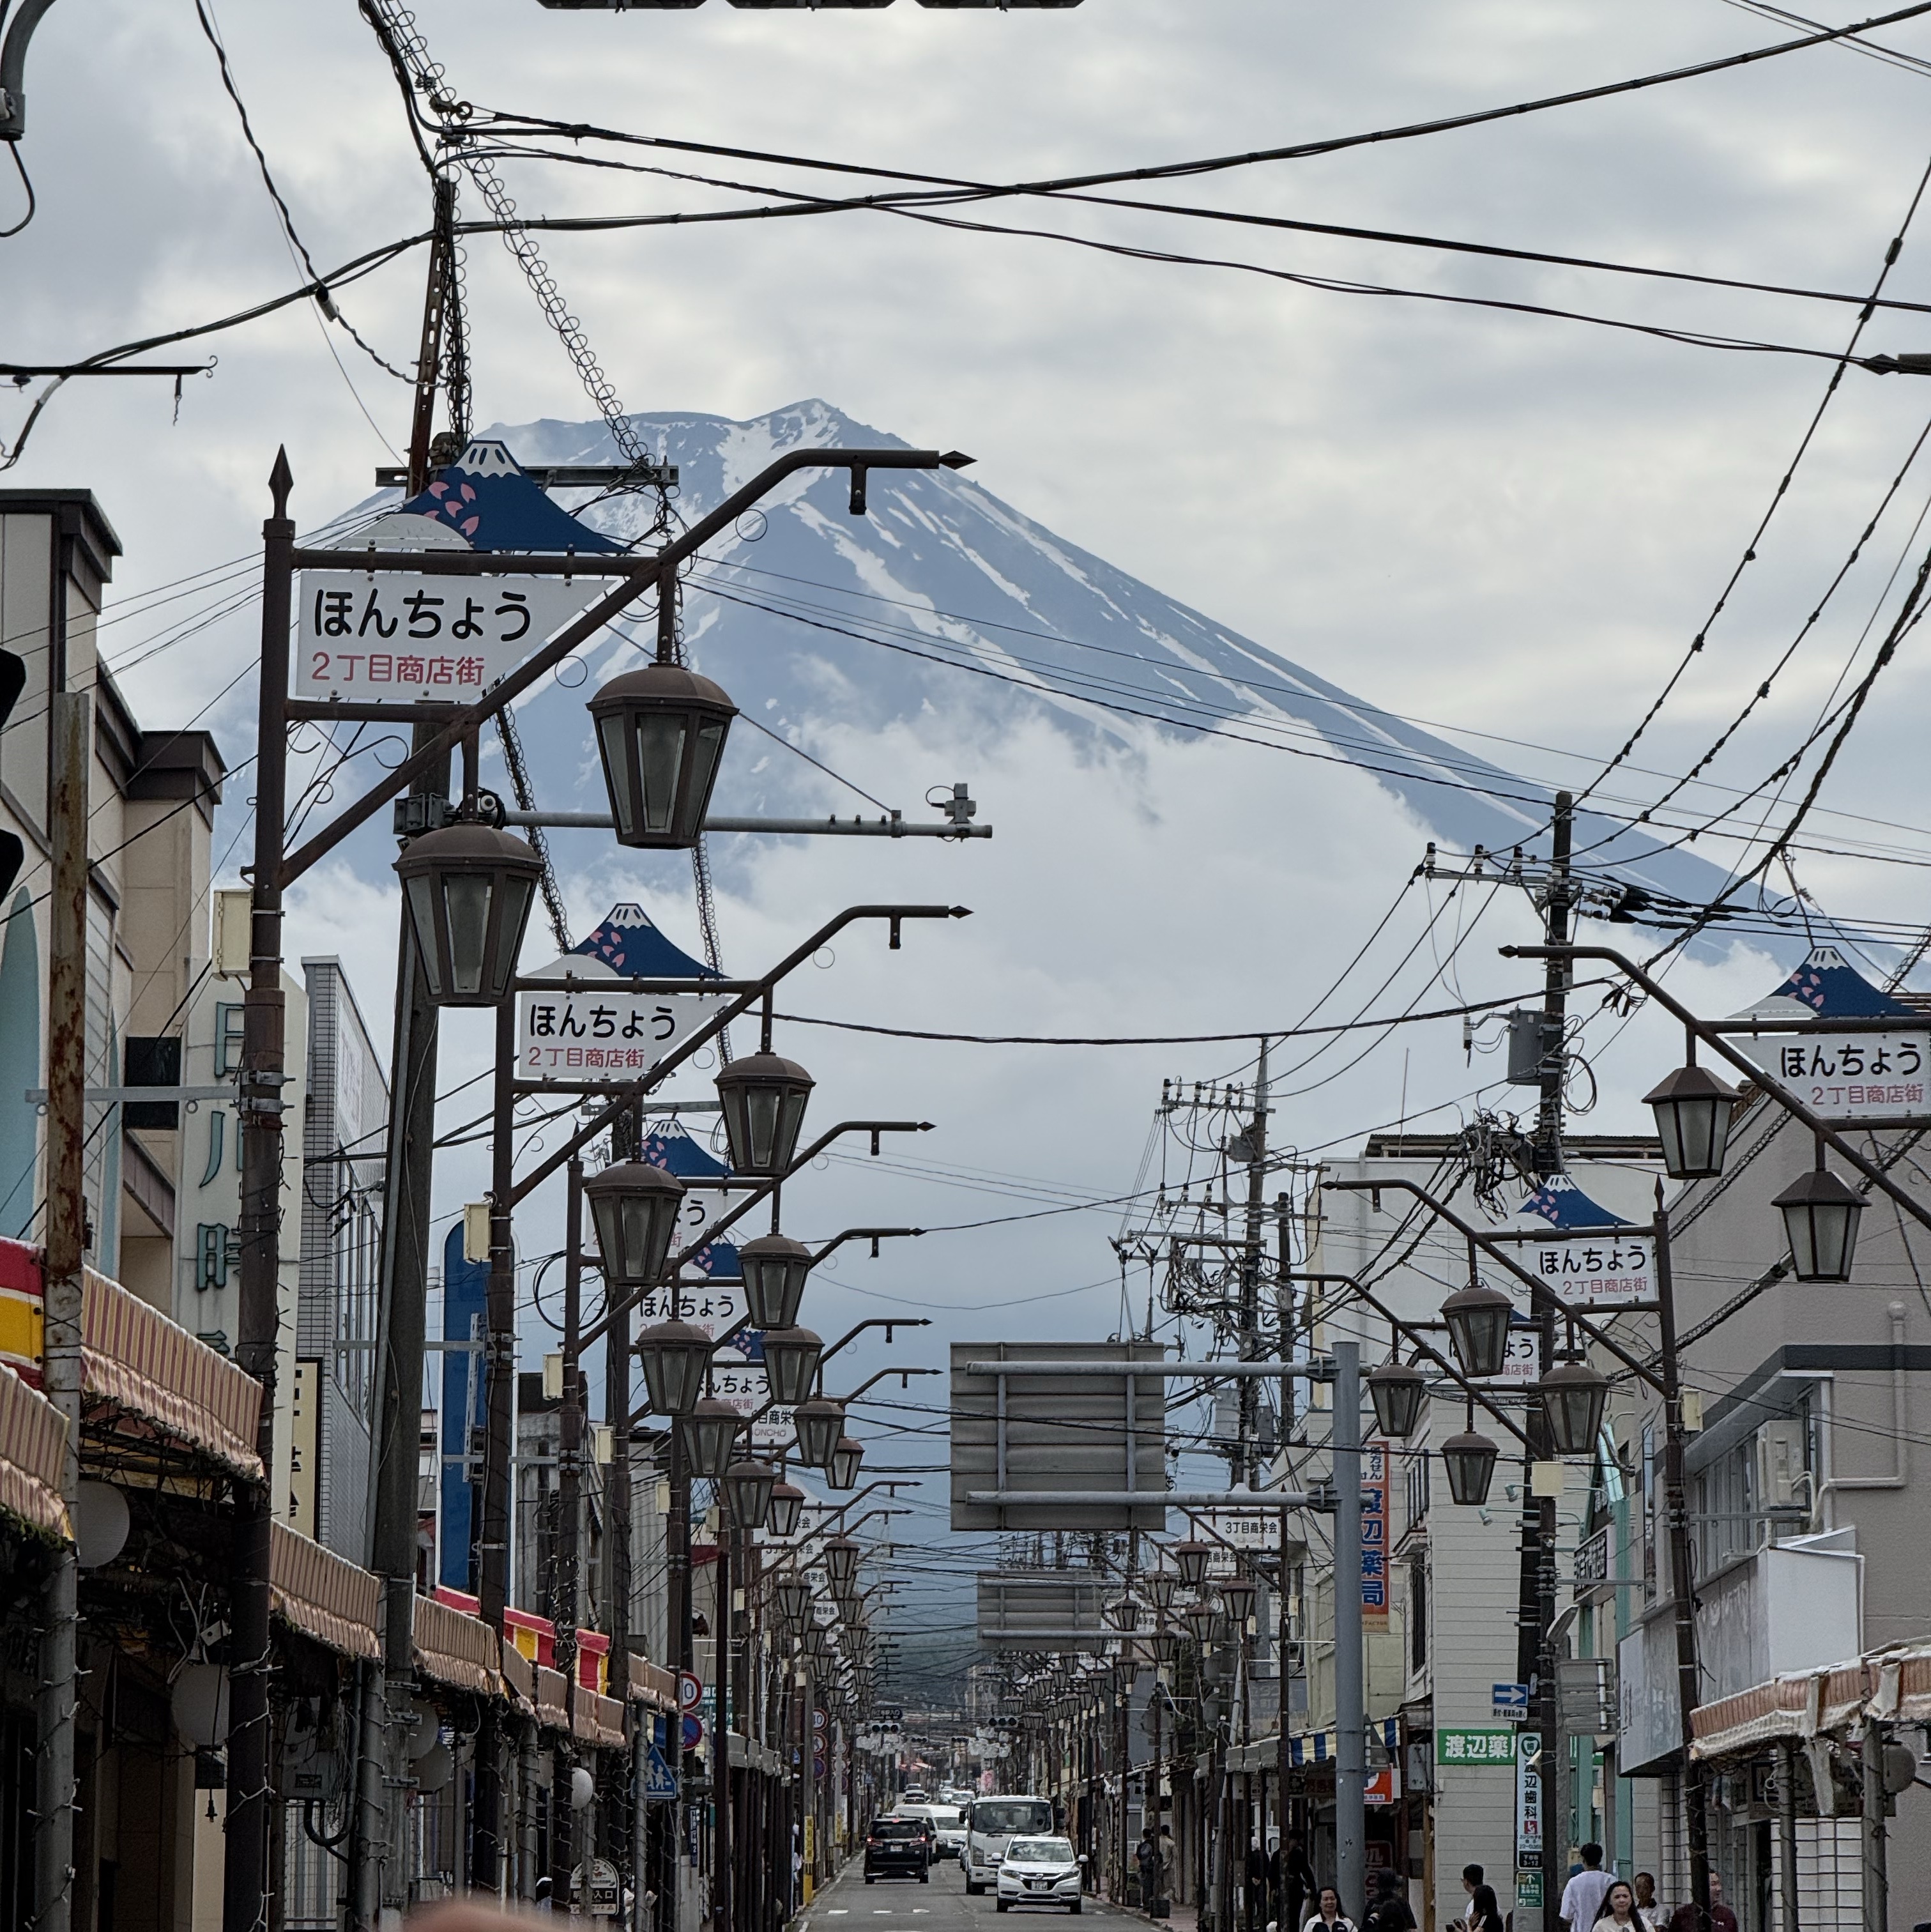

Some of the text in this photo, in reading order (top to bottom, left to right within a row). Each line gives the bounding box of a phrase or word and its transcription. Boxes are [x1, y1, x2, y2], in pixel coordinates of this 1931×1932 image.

[314, 588, 531, 641] ほんちょう
[311, 652, 484, 686] 2丁目商店街
[530, 1004, 675, 1041] ほんちょう
[528, 1046, 645, 1068] 2丁目商店街
[1781, 1042, 1921, 1078] ほんちょう
[1812, 1084, 1924, 1105] 2丁目商店街
[1540, 1245, 1645, 1275] ほんちょう
[1562, 1276, 1647, 1294] 2丁目商店街
[1225, 1522, 1277, 1533] 3丁目商栄会
[684, 1683, 694, 1699] 0
[1446, 1735, 1516, 1758] 渡辺薬
